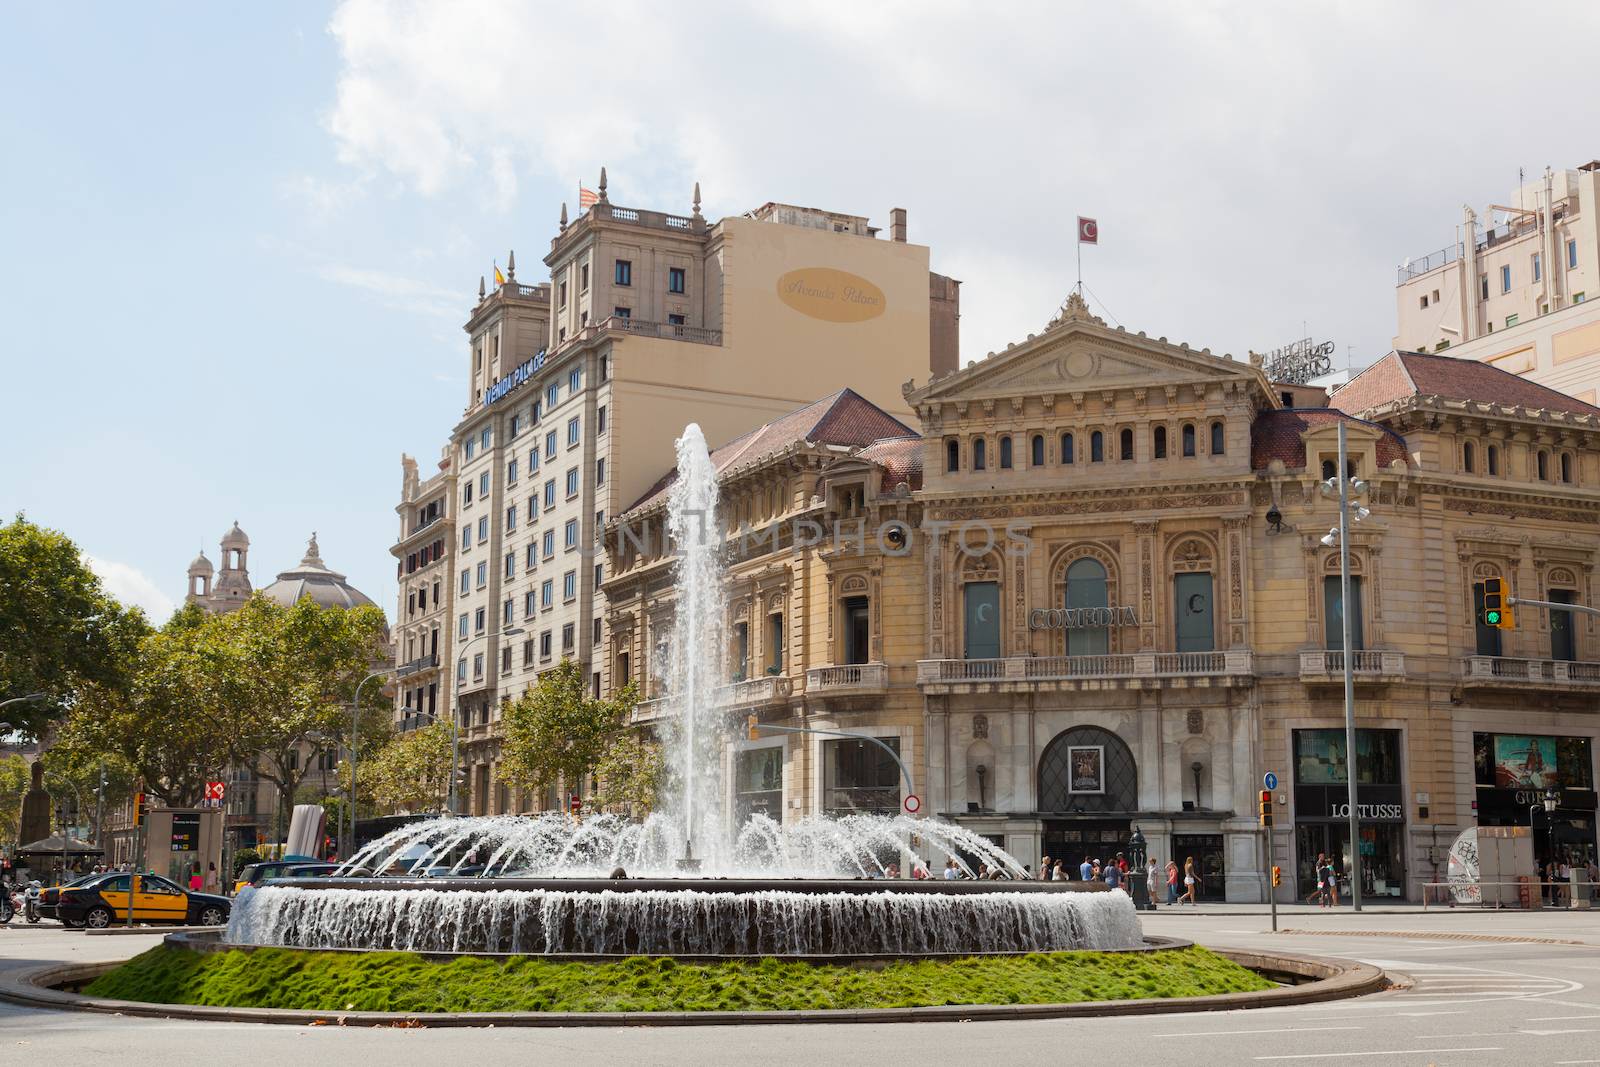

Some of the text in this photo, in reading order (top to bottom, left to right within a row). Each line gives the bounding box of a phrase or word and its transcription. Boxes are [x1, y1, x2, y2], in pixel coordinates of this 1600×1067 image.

[482, 350, 545, 407] AVENIDA PALACE
[1029, 606, 1140, 630] COMEDIA
[1331, 803, 1402, 819] LOTUSSE
